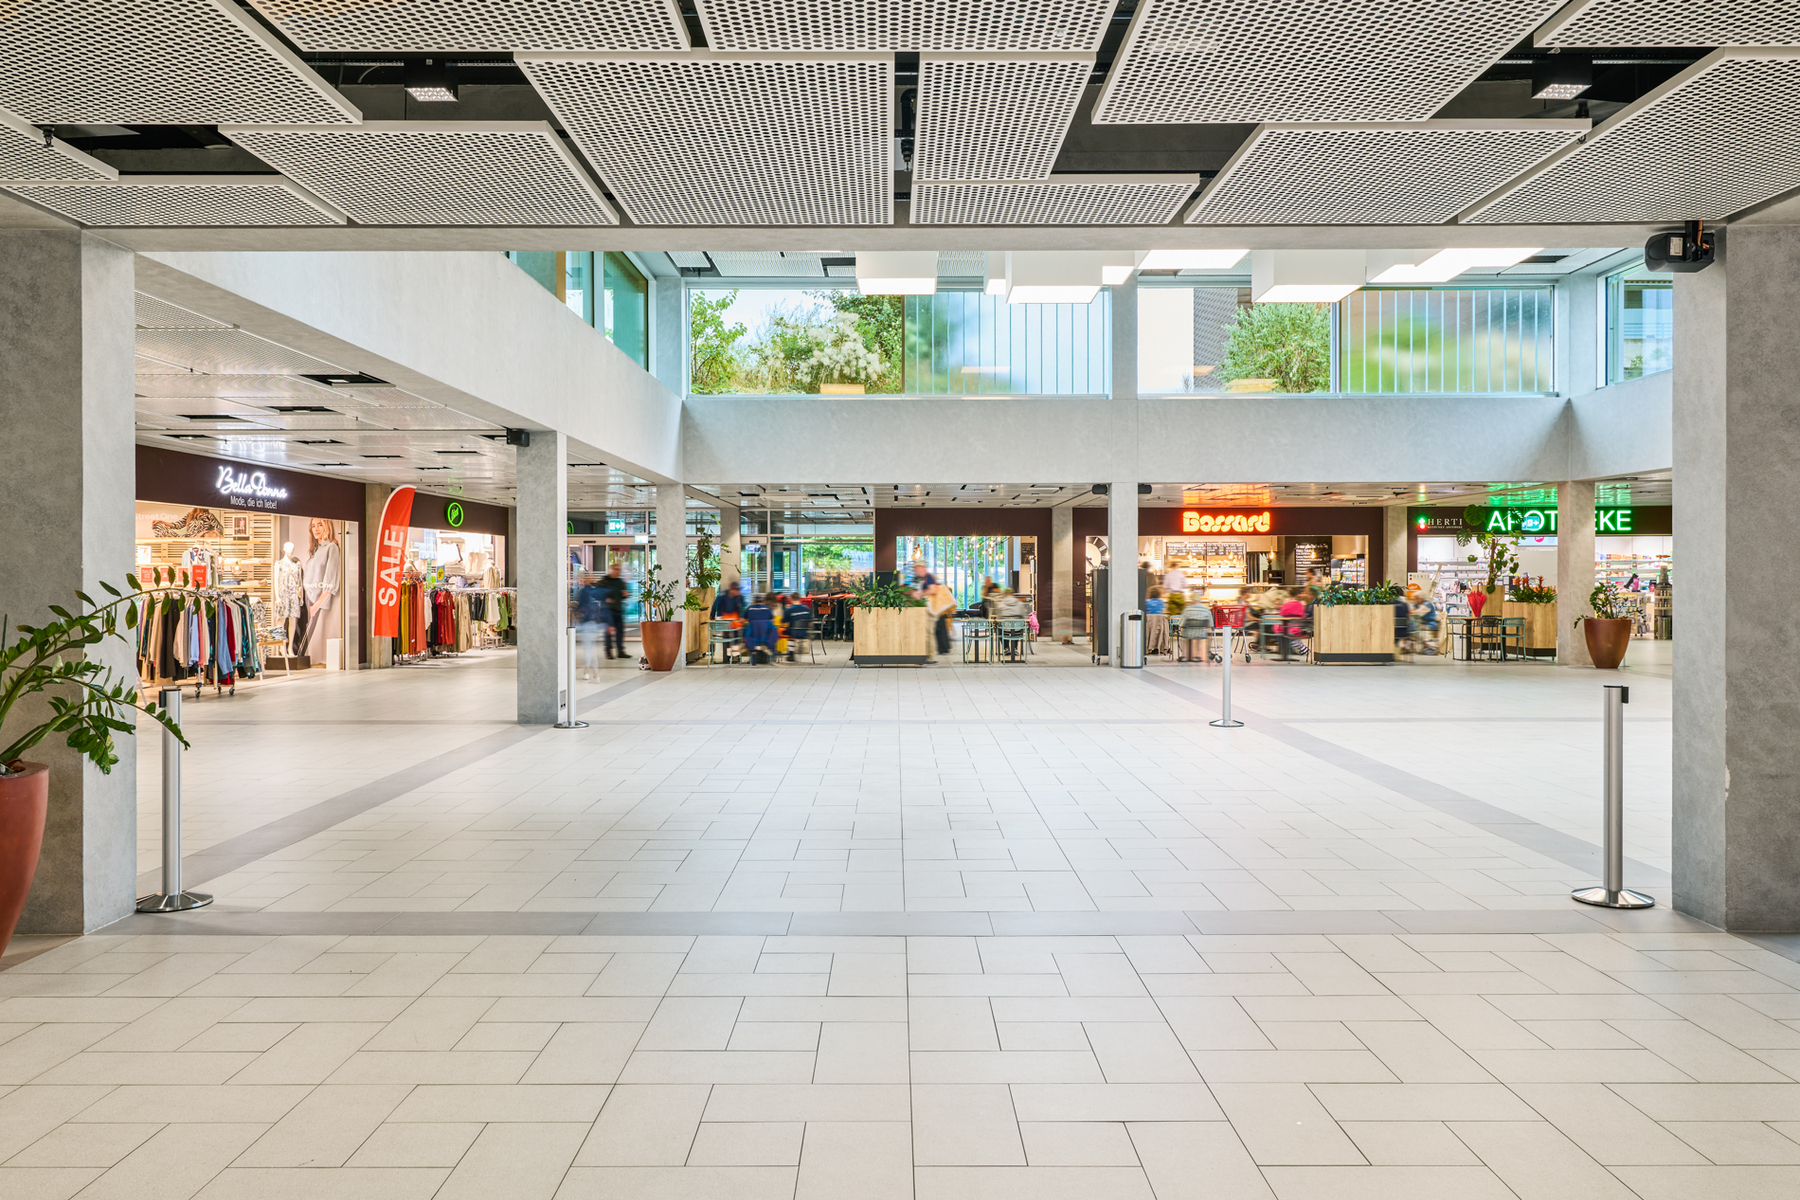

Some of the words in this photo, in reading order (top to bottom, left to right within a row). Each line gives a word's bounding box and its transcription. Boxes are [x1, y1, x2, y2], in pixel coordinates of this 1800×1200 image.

[230, 495, 247, 508] Mode,
[247, 497, 256, 508] die
[256, 498, 264, 508] ich
[160, 513, 179, 521] One
[1182, 510, 1271, 532] Bossard
[1427, 518, 1463, 526] HERTI
[378, 529, 404, 607] SALE
